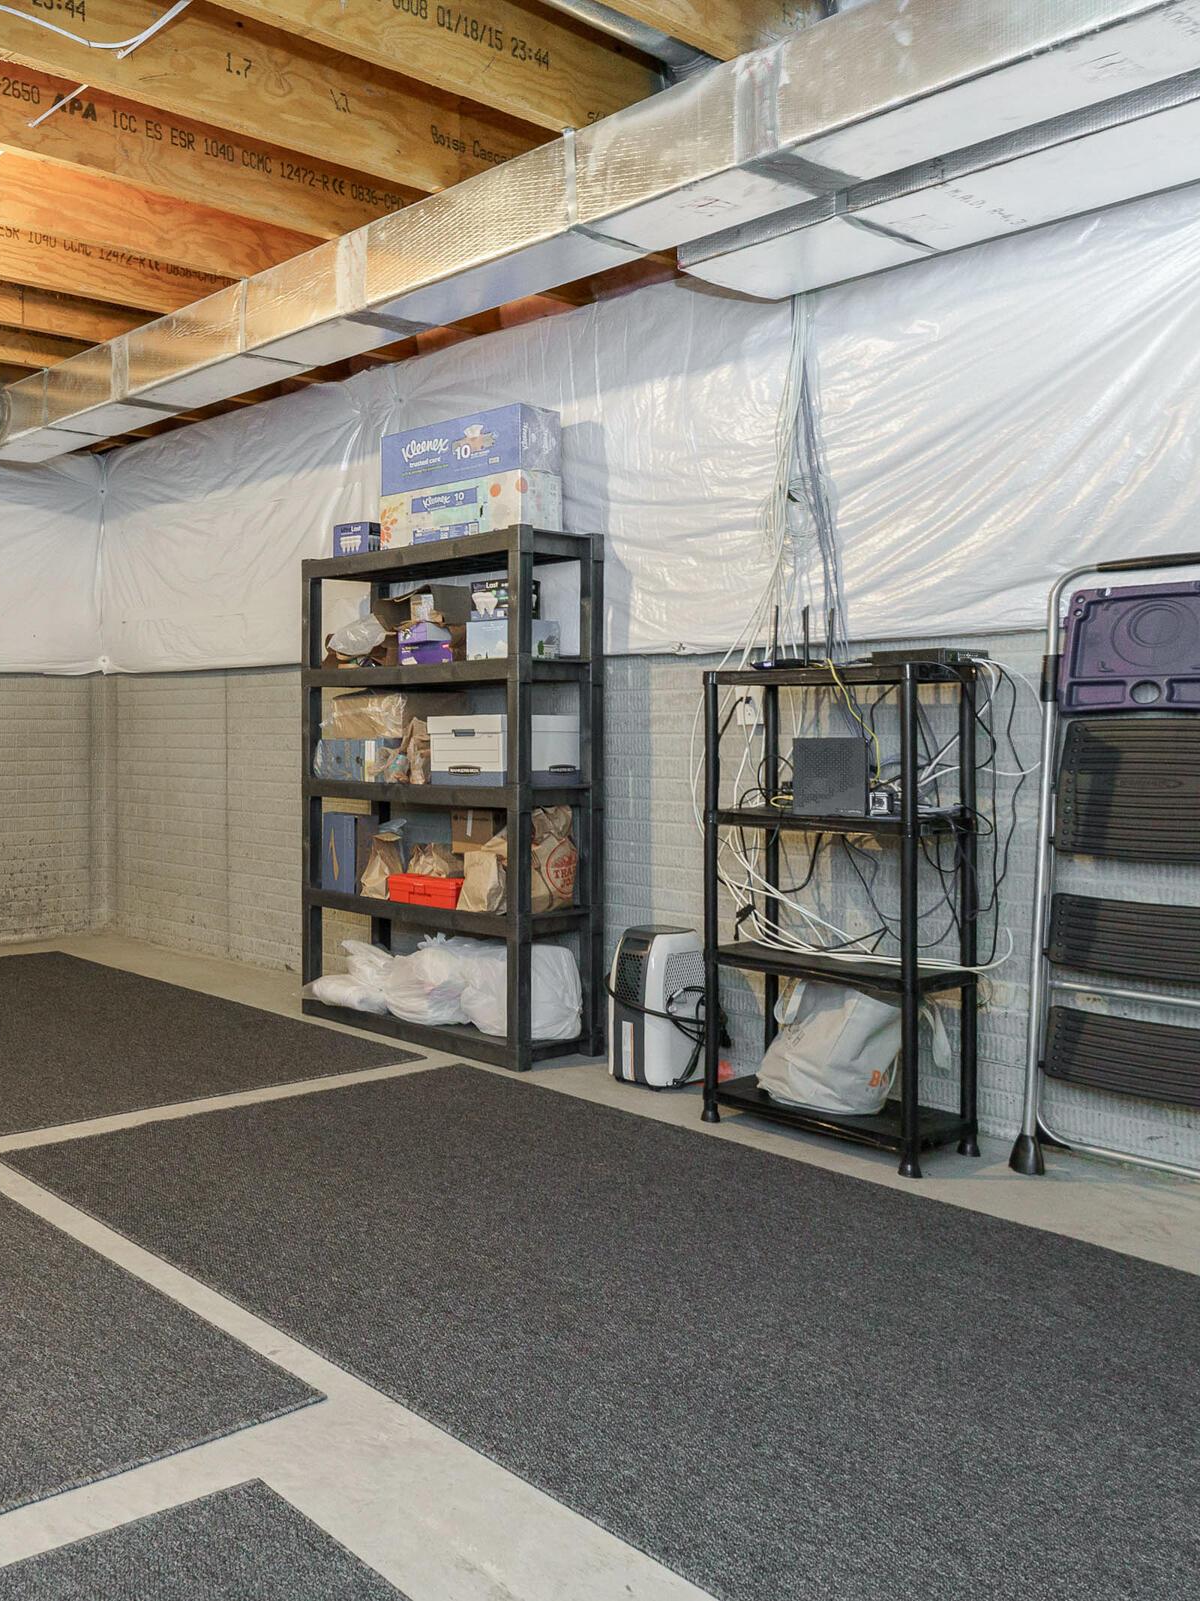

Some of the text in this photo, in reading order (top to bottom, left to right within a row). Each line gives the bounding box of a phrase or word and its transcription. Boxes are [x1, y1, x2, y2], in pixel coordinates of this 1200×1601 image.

[437, 5, 503, 52] 01/18/15
[511, 37, 549, 70] 23:44
[225, 52, 252, 78] 1.7
[52, 93, 97, 122] APA
[112, 109, 138, 133] ICC
[145, 120, 163, 141] ES
[170, 128, 195, 151] ESR
[204, 138, 235, 163] 1040
[241, 149, 272, 174] CCMC
[430, 124, 466, 153] Boise
[402, 439, 448, 462] Kleenex
[455, 445, 470, 459] 10
[423, 492, 464, 510] Kleenex 10
